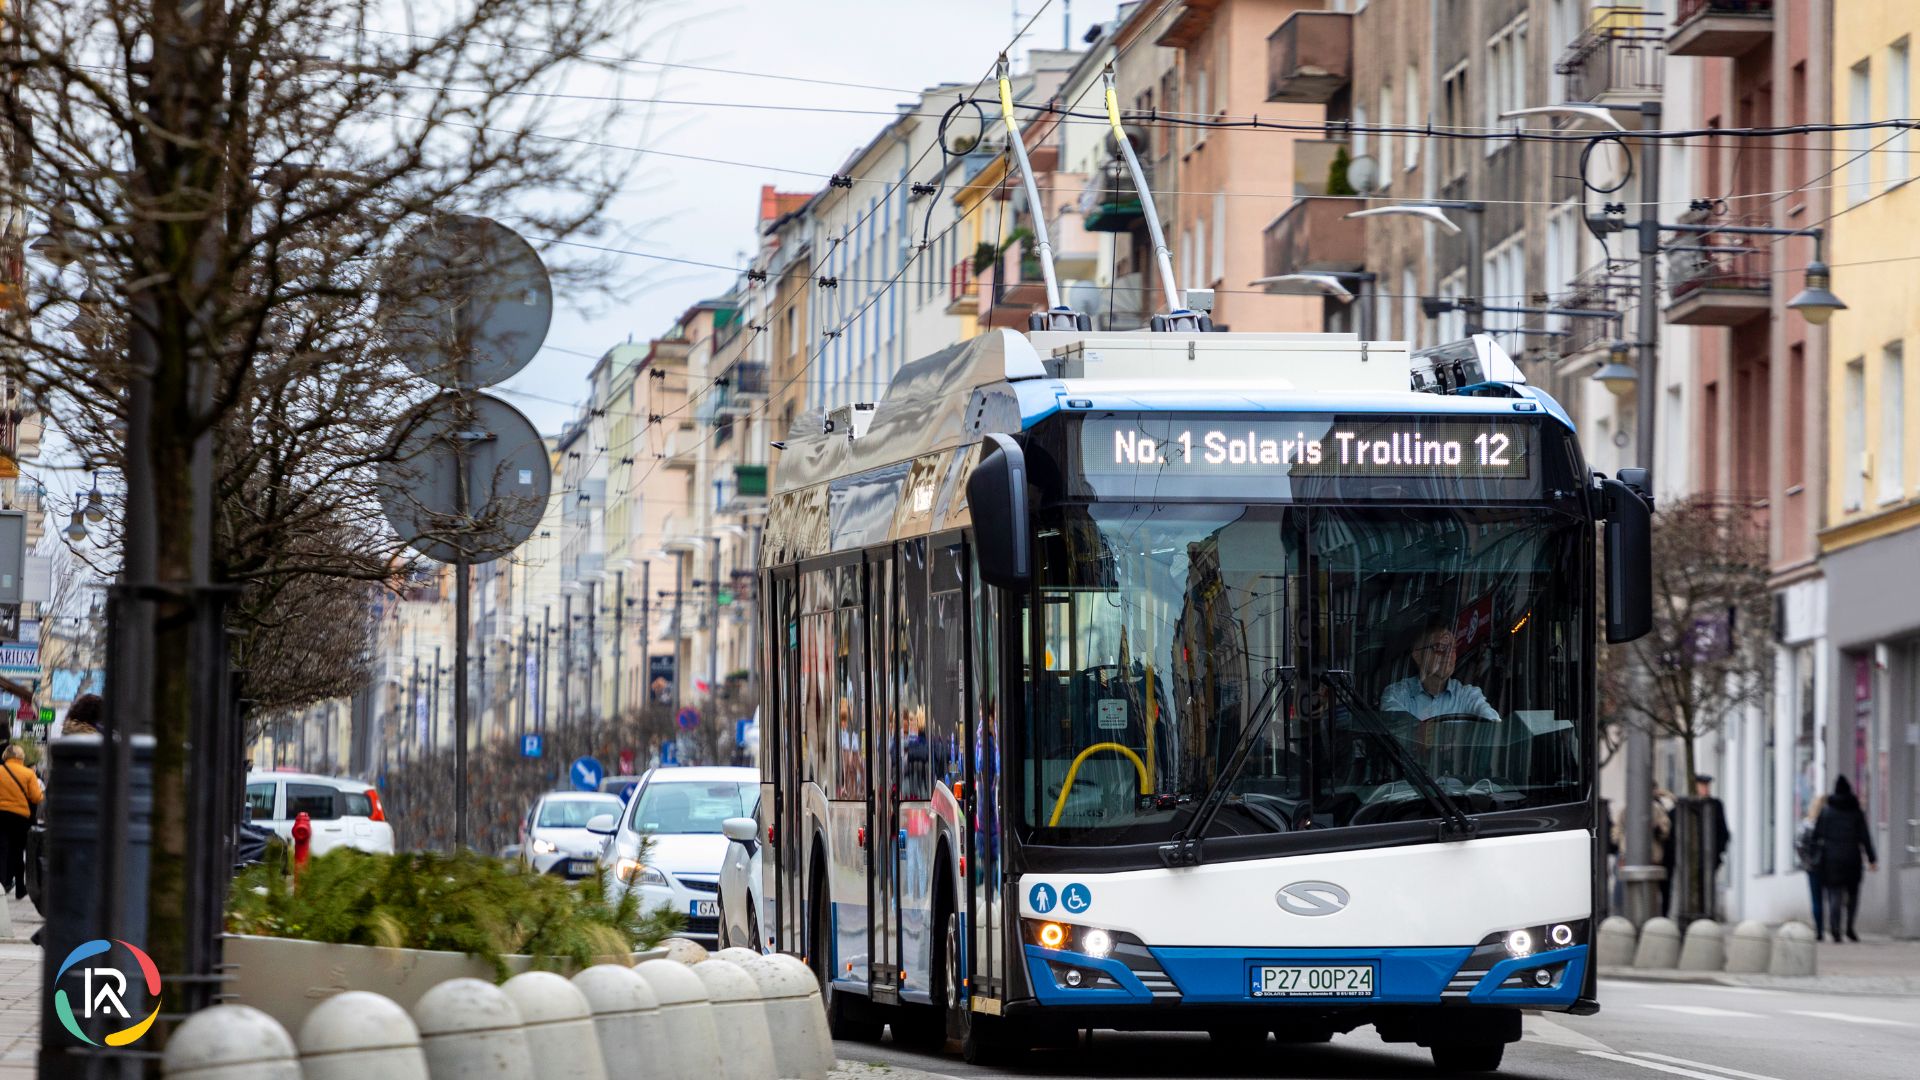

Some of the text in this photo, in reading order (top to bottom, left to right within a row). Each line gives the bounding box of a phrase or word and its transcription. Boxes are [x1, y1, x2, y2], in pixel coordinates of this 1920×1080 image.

[1114, 430, 1510, 466] No. 1 Solaris Trollino 12
[699, 902, 715, 914] GA
[1264, 969, 1371, 989] P27 00P24
